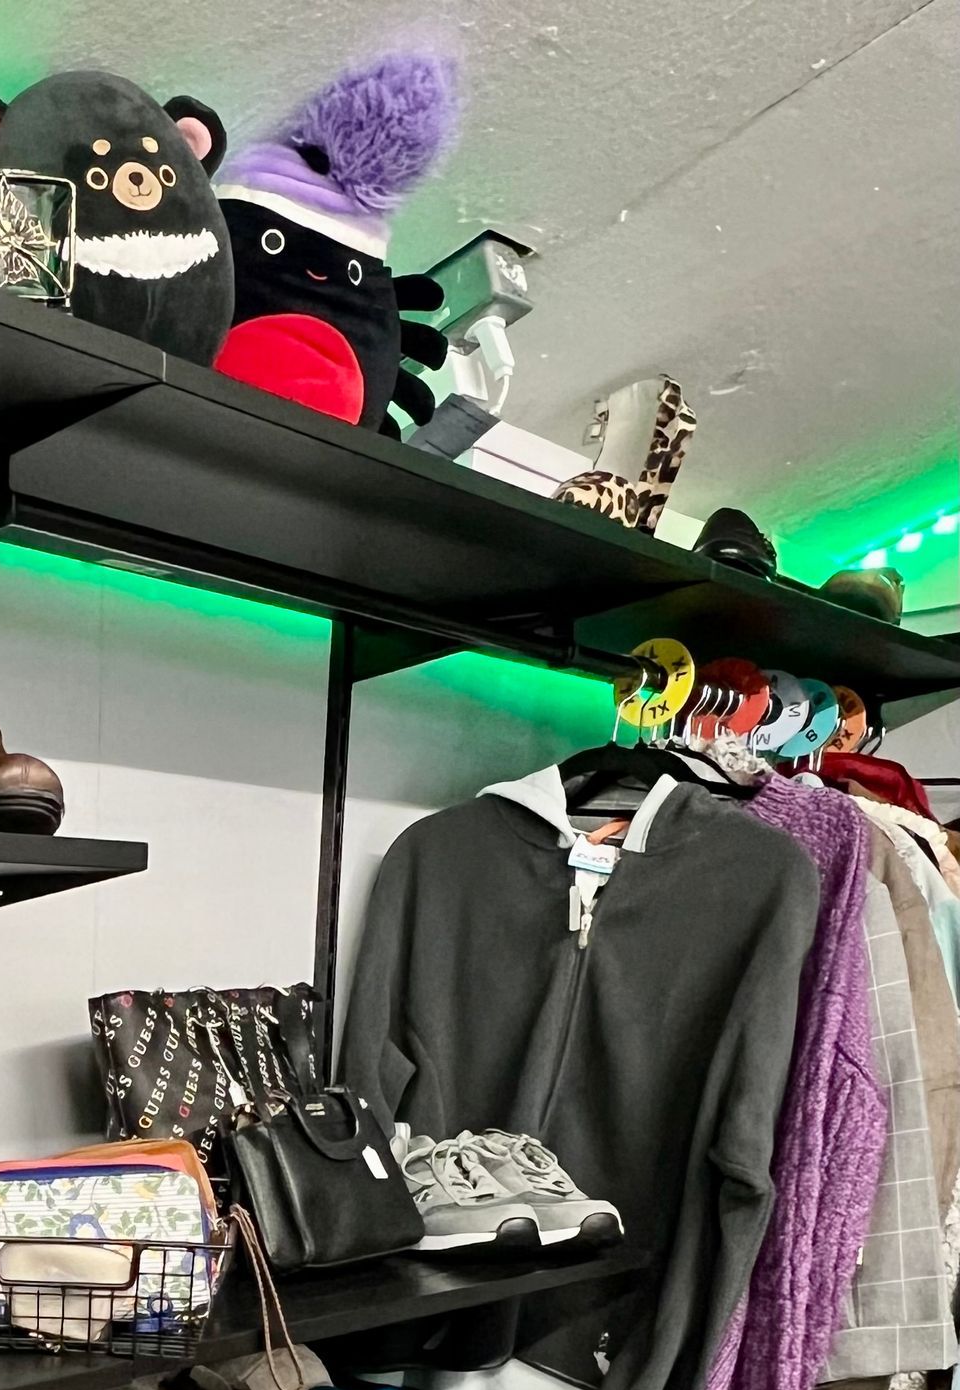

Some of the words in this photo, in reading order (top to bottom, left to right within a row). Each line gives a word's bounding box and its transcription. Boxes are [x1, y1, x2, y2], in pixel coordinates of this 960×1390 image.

[648, 701, 670, 719] XL
[128, 1007, 158, 1068] GUESS
[138, 1066, 172, 1129] GUESS
[179, 1058, 203, 1118] GUESS
[198, 1114, 219, 1165] UESS
